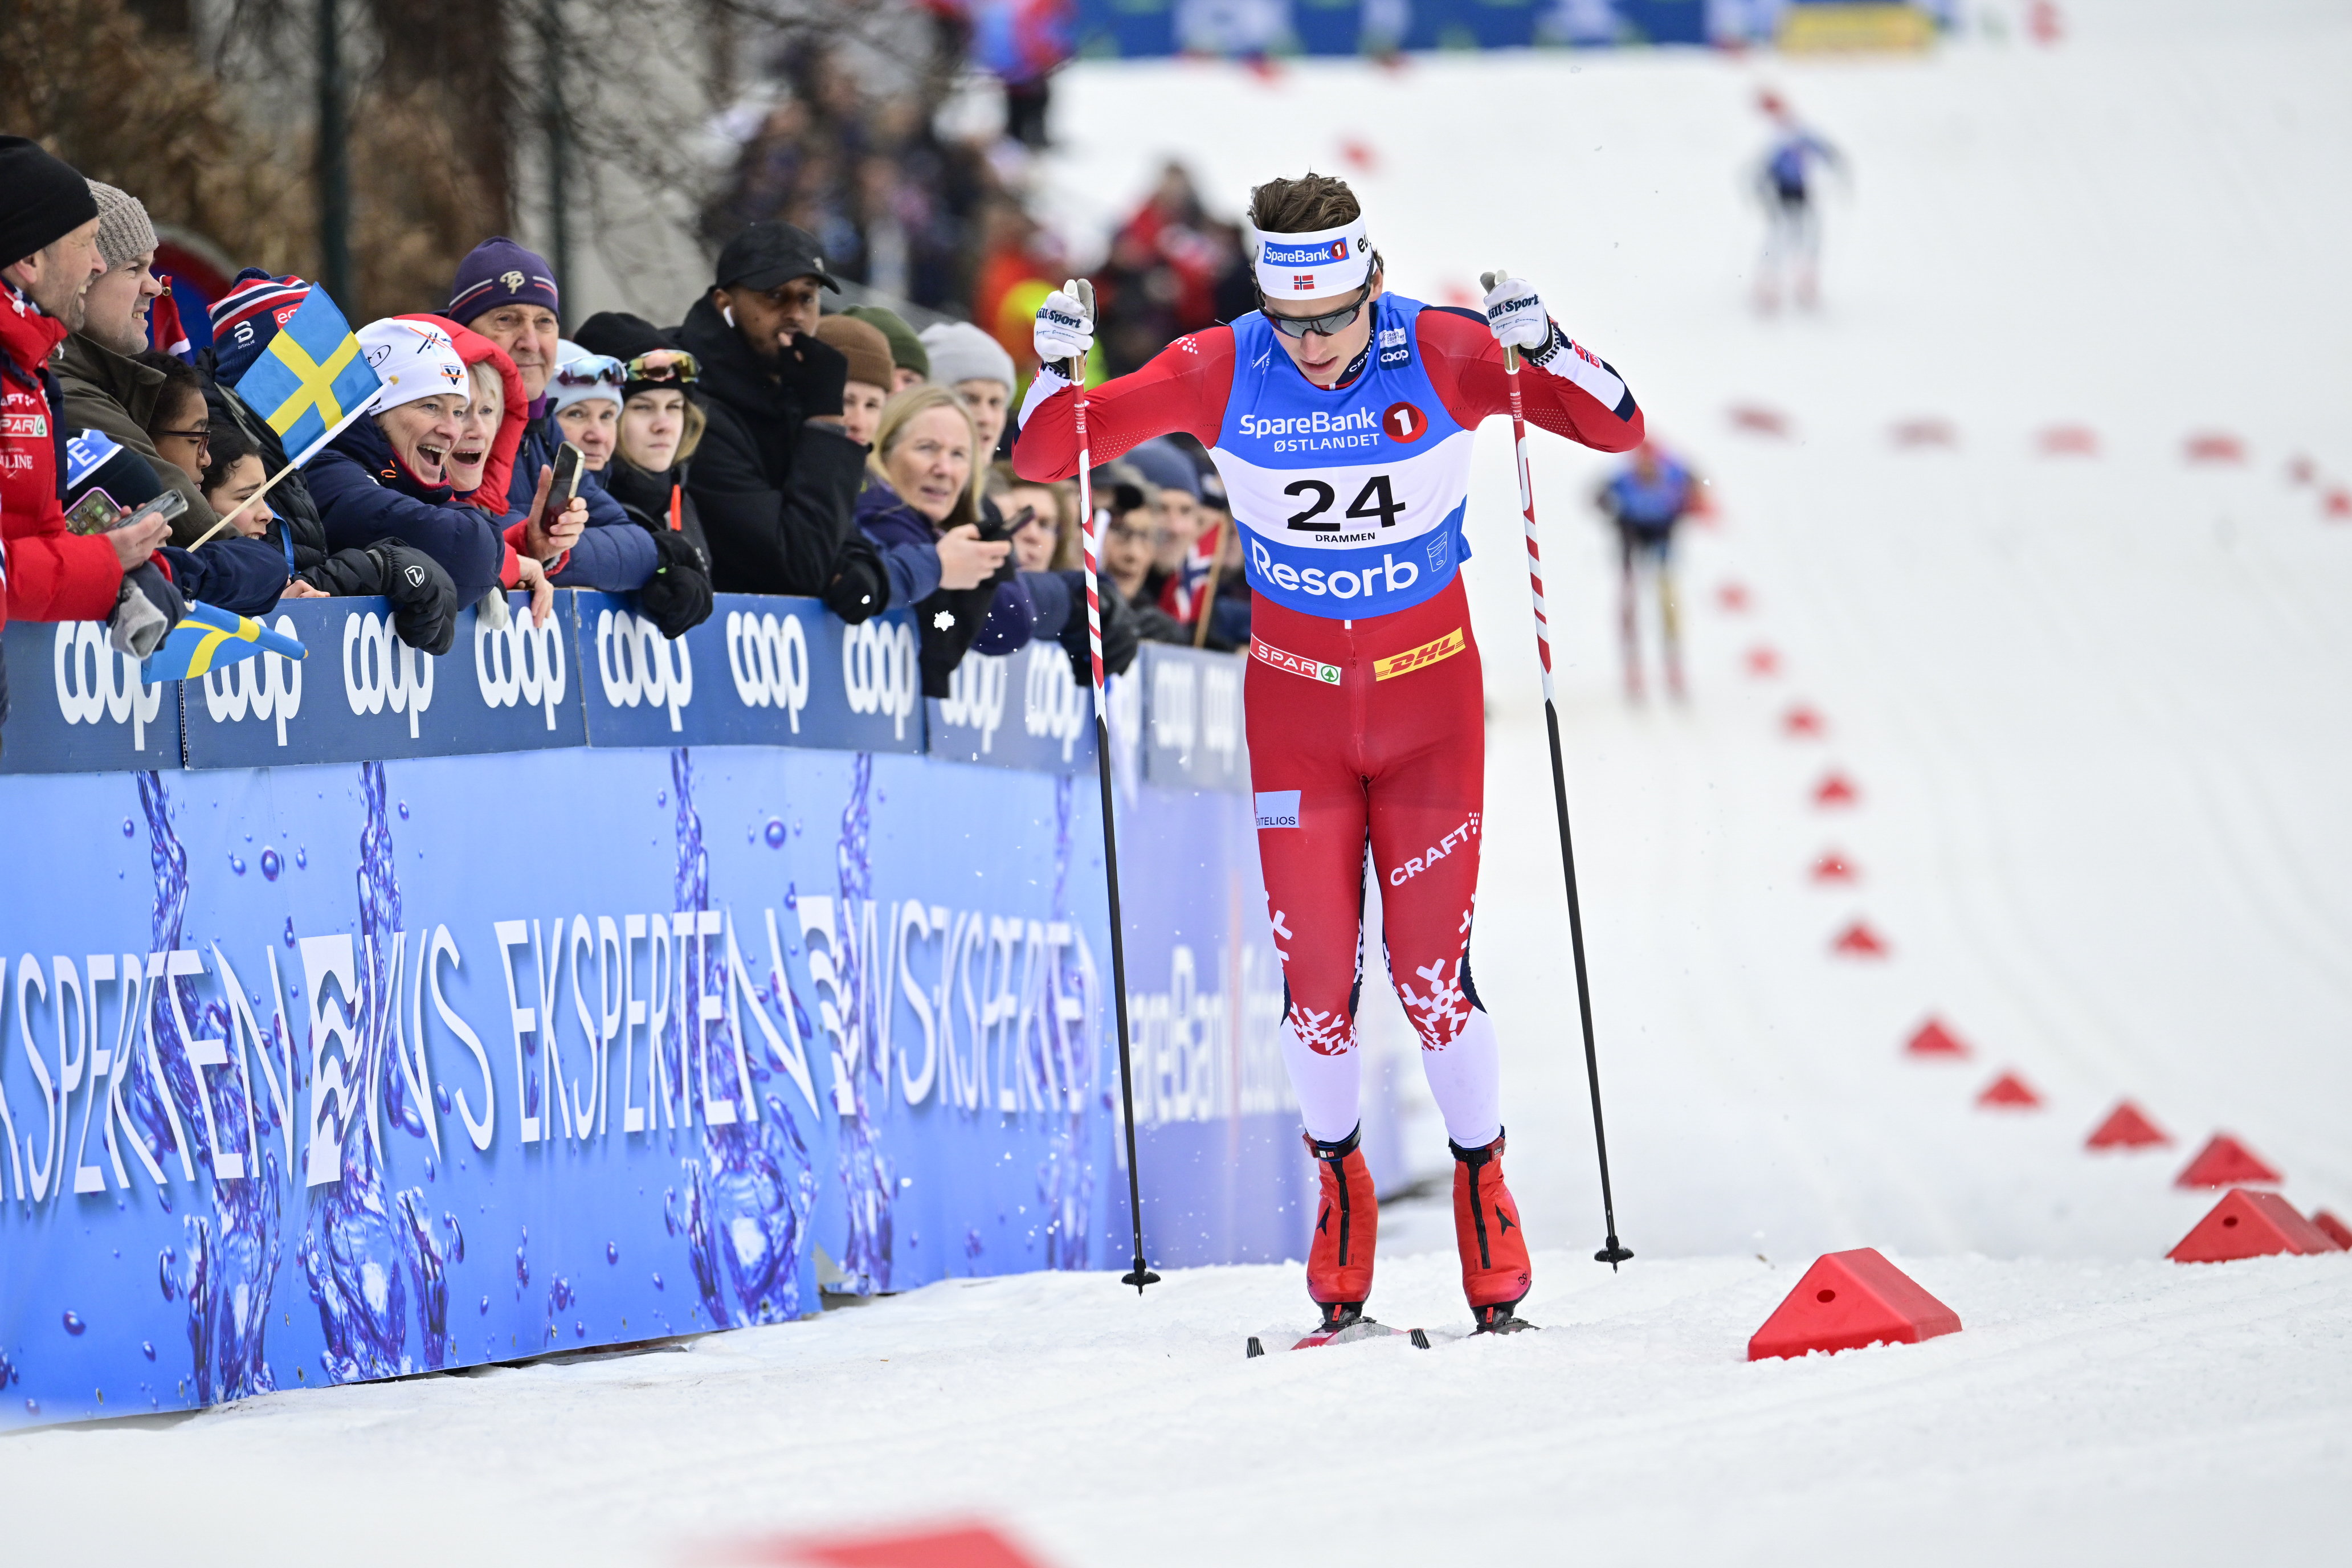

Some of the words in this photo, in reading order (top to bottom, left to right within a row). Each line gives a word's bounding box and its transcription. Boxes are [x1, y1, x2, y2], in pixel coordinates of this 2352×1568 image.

[1265, 247, 1330, 263] SpareBank
[1334, 243, 1342, 256] 1
[1381, 350, 1408, 362] coop
[0, 419, 34, 432] PAR
[1239, 407, 1378, 438] SpareBank
[1394, 409, 1413, 436] 1
[1274, 434, 1380, 452] ØSTLANDET
[1284, 475, 1406, 532] 24
[1315, 532, 1375, 542] DRAMMEN
[1251, 537, 1419, 599] Resorb
[343, 611, 434, 738] coop
[475, 606, 566, 730] coop
[597, 609, 693, 732] coop
[726, 611, 808, 734] coop
[843, 619, 914, 740] coop
[1258, 645, 1316, 675] SPAR
[1390, 636, 1457, 674] DHL
[1390, 822, 1468, 886] CRAFT
[494, 904, 821, 1142] EKSPERTEN
